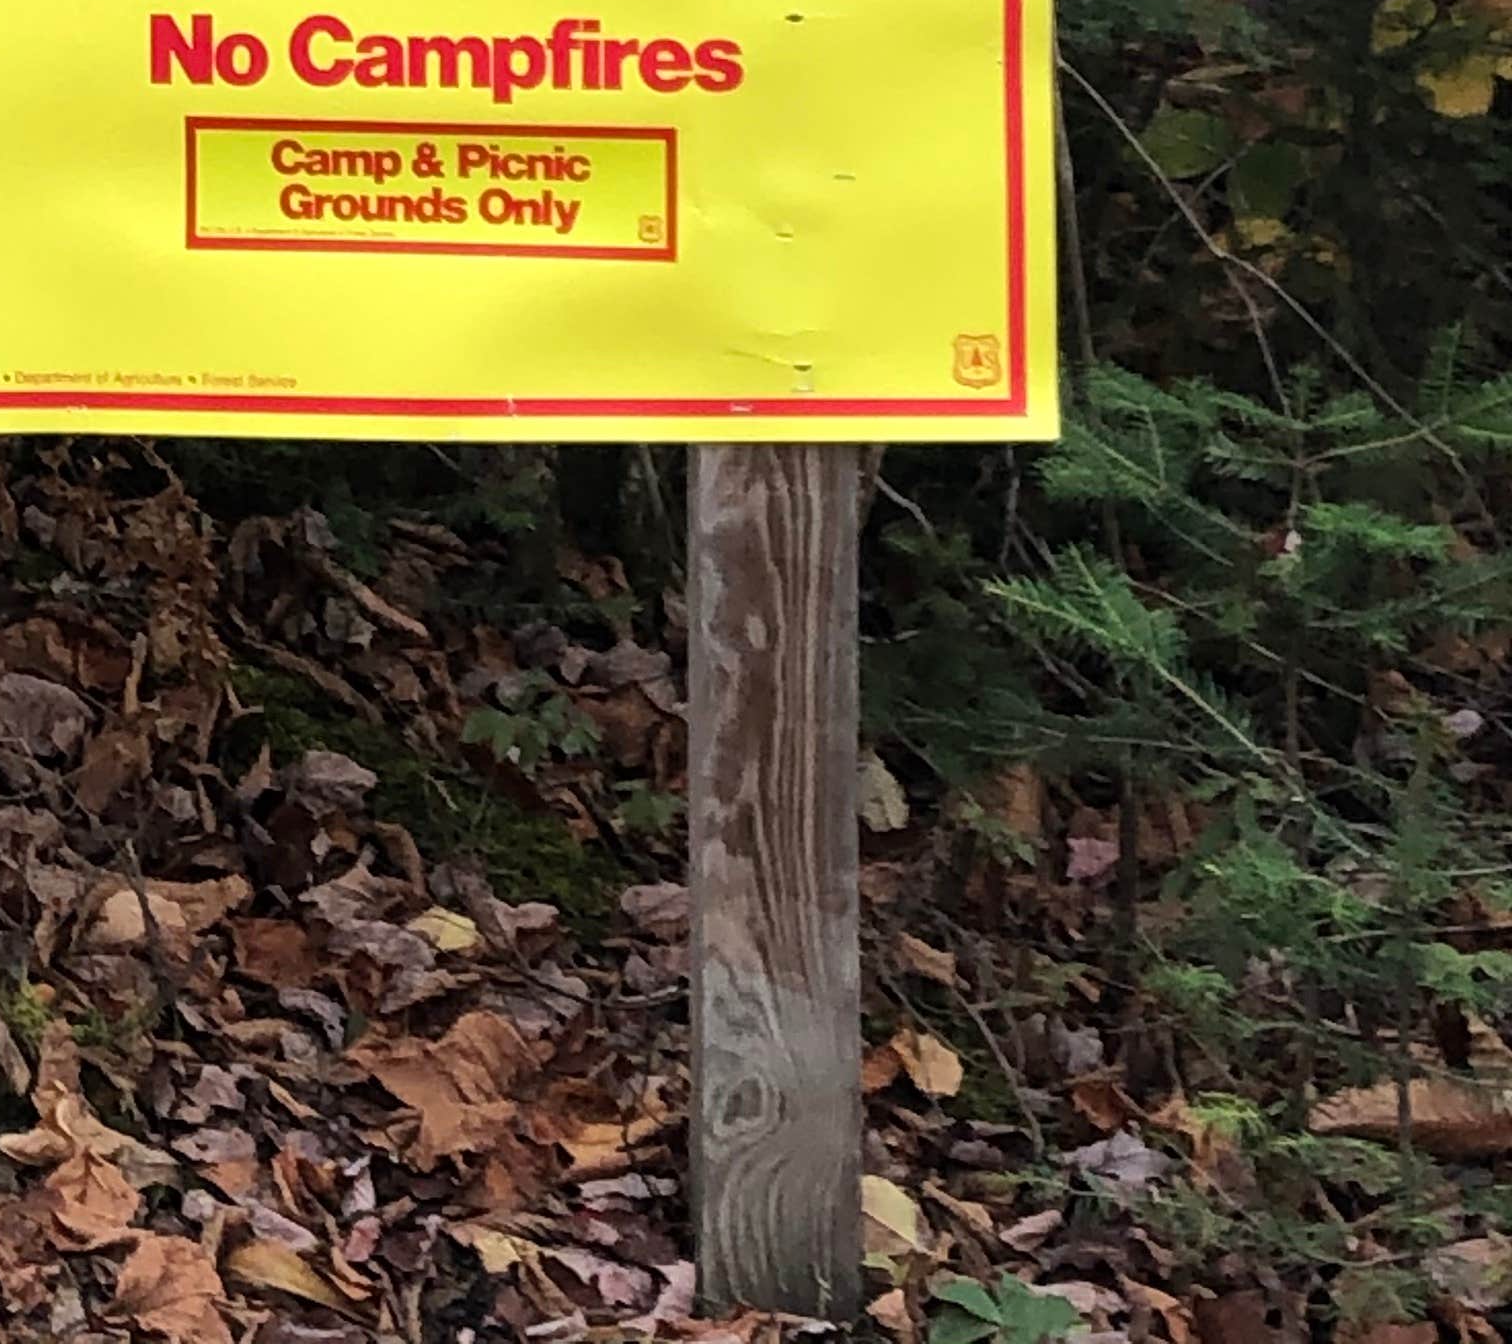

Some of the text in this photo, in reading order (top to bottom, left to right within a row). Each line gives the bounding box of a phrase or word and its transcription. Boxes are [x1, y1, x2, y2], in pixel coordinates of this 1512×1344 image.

[151, 14, 743, 103] No Campfires
[271, 139, 592, 185] Camp & Picnic
[280, 184, 579, 233] Grounds Only
